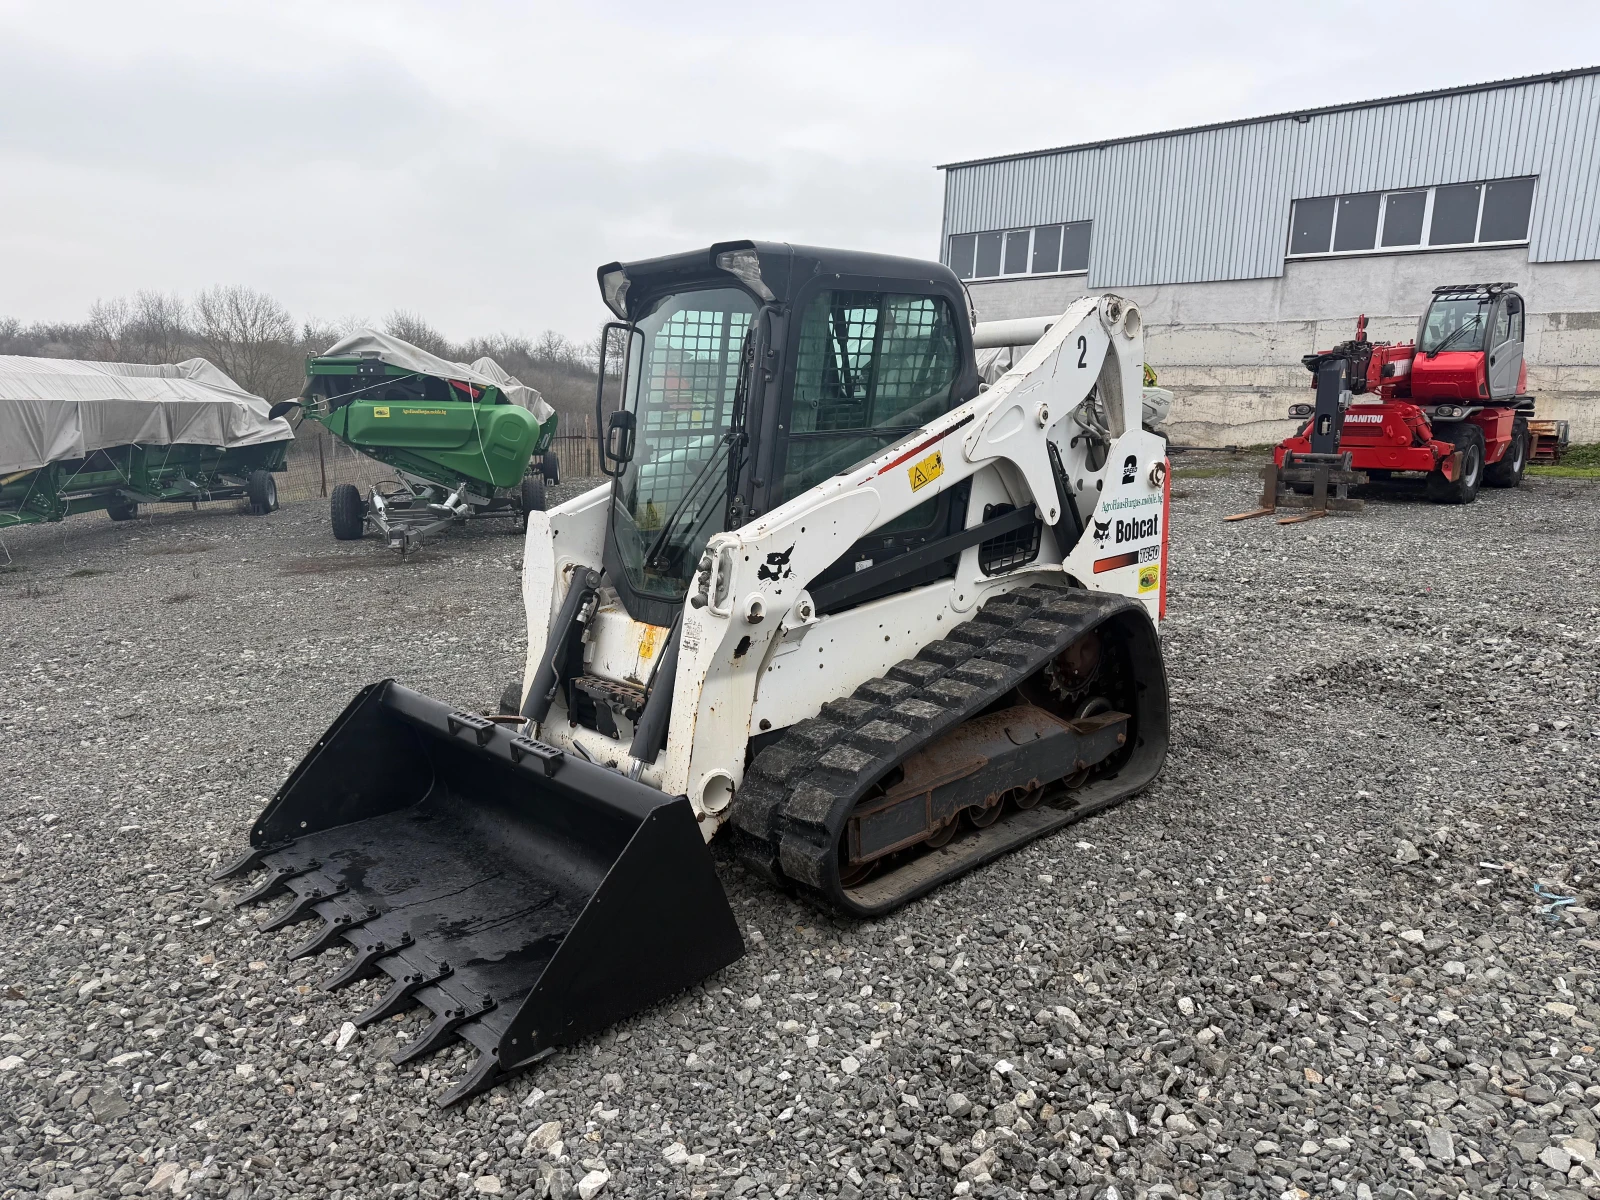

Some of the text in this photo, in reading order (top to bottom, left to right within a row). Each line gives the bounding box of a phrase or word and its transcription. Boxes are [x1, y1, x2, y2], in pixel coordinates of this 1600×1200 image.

[1077, 335, 1087, 369] 2
[1344, 415, 1384, 423] MANITOU
[1122, 466, 1138, 475] SPEED
[1115, 513, 1159, 544] Bobcat
[1139, 544, 1160, 563] T650
